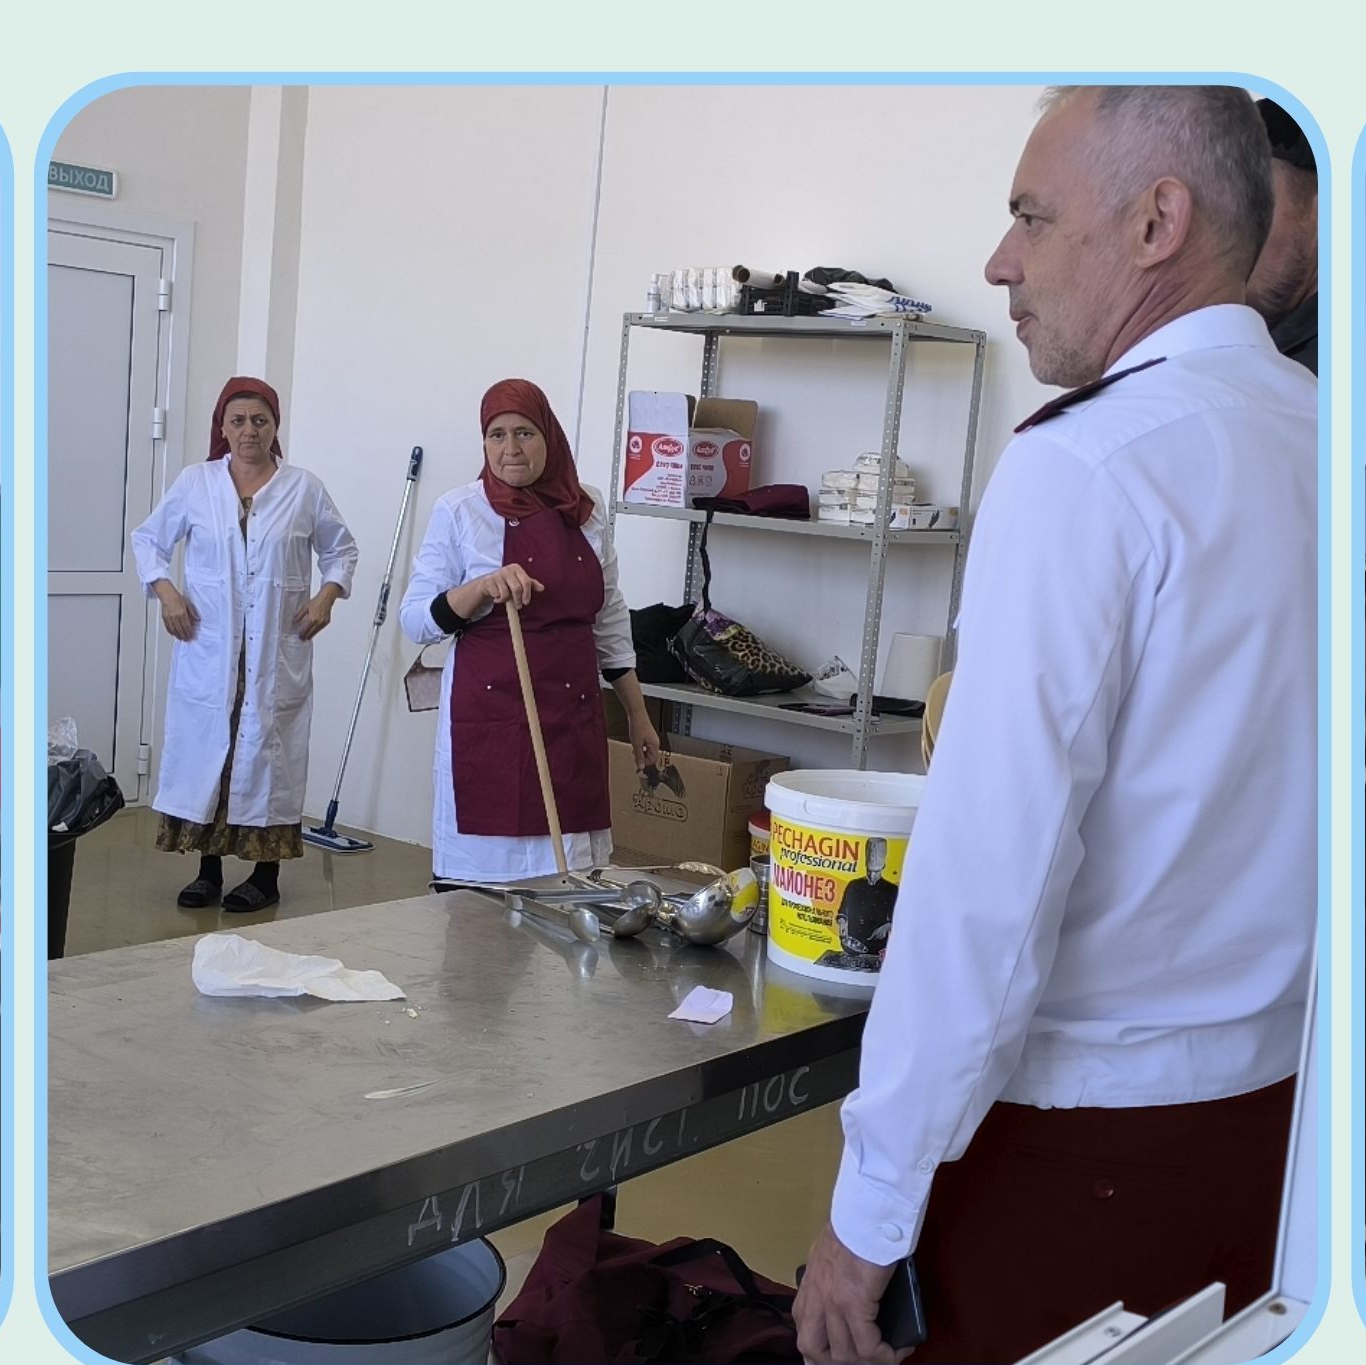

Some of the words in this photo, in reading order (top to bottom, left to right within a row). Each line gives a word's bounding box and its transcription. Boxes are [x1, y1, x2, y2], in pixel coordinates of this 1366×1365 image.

[49, 165, 109, 191] ВЫХОД
[772, 821, 860, 861] PECHAGIN
[780, 847, 858, 873] professional
[773, 863, 836, 903] МАЙОНЕЗ
[407, 1166, 526, 1247] ДЛЯ
